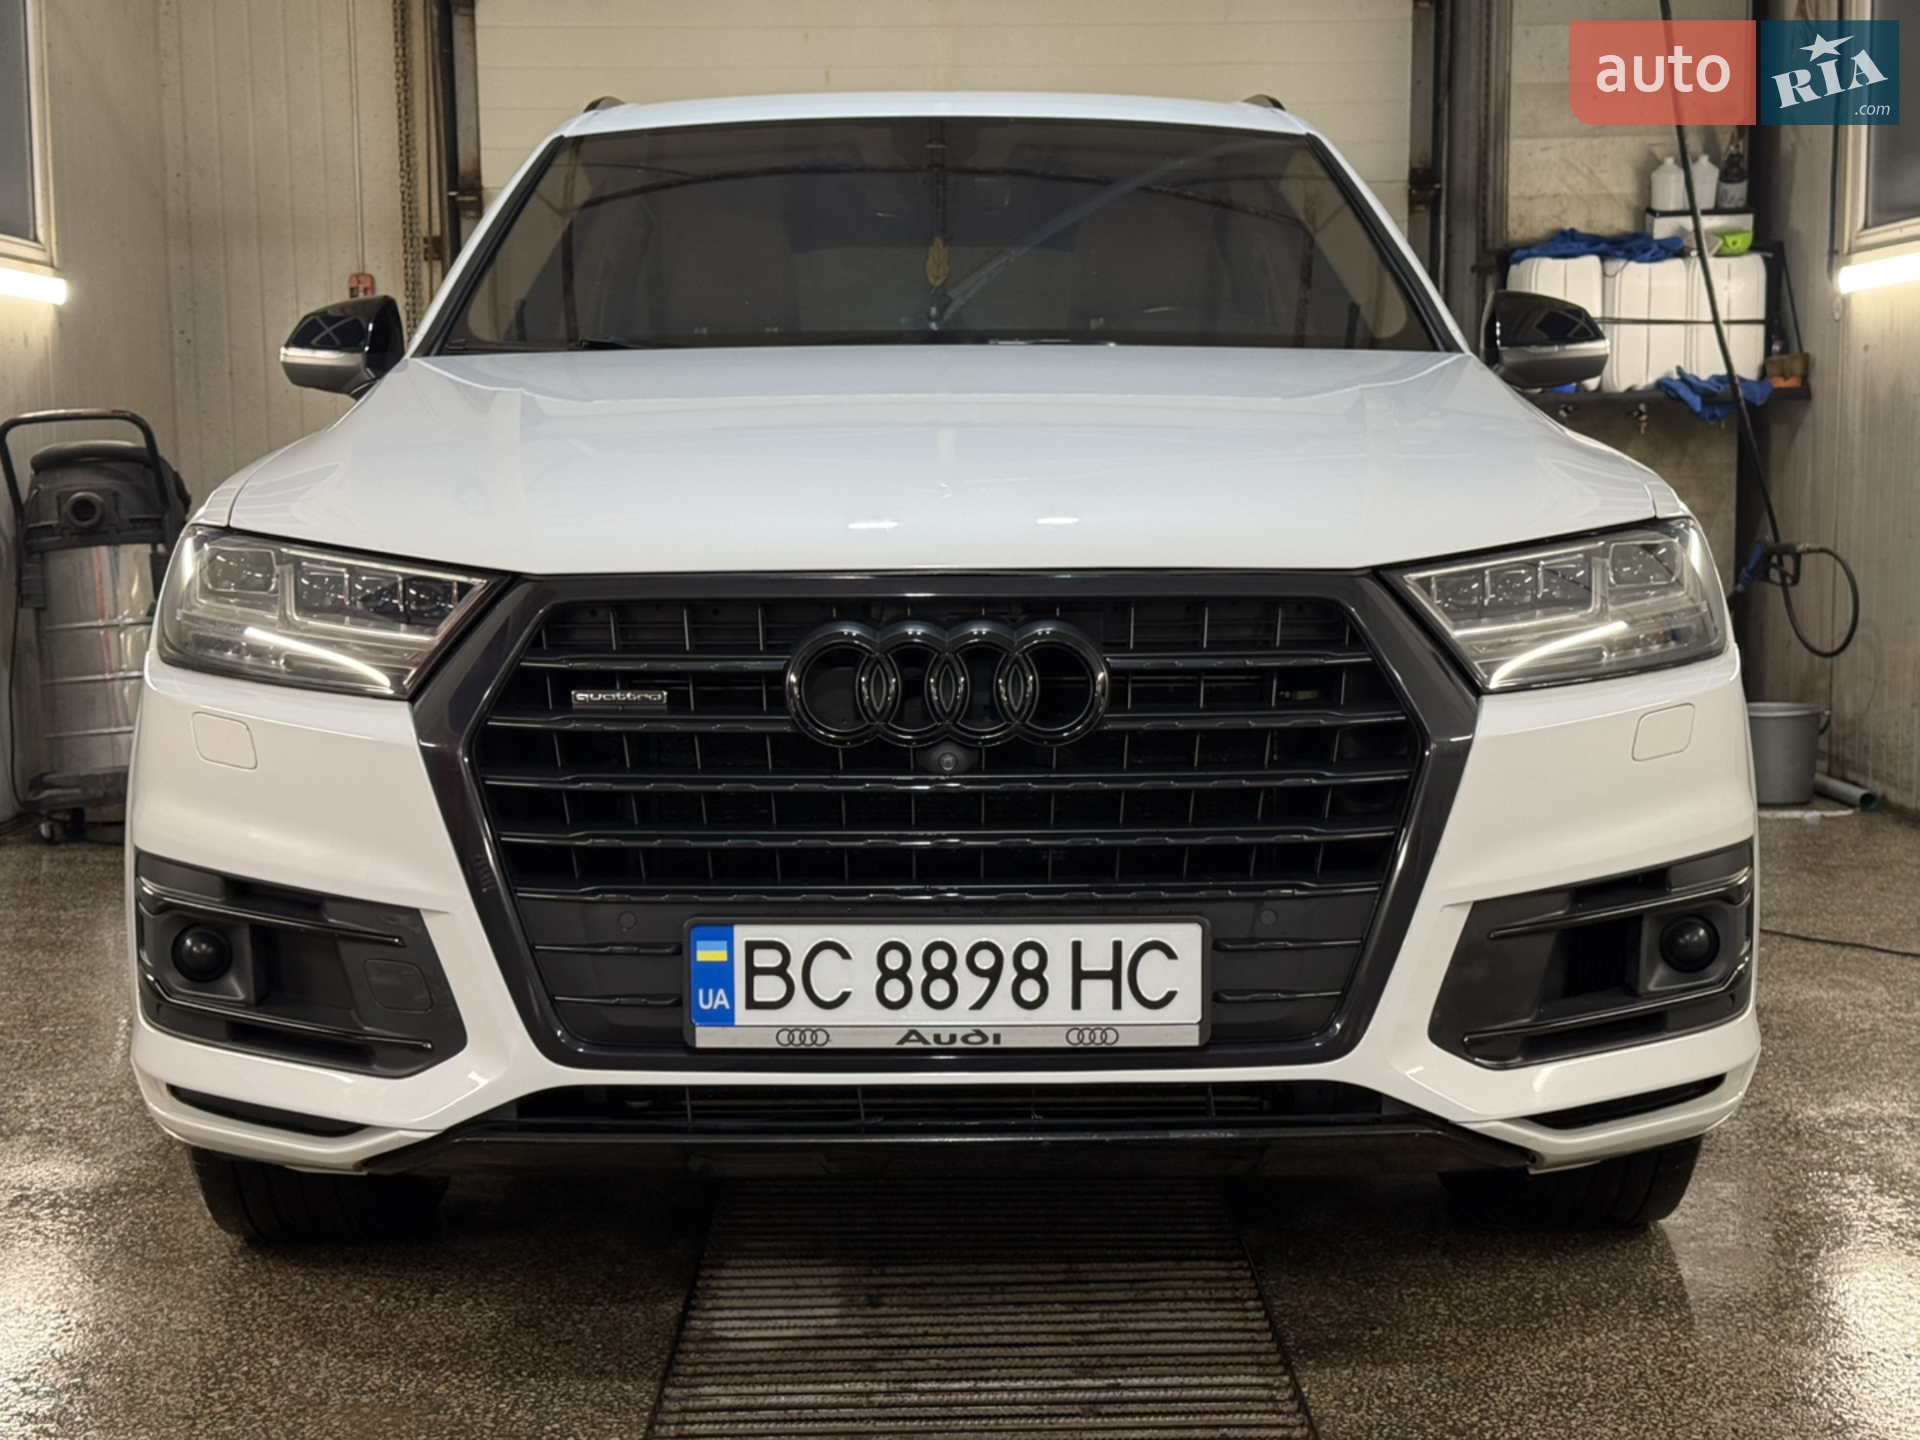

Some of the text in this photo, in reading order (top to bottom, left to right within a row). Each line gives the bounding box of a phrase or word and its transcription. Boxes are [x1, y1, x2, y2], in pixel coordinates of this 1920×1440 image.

[575, 692, 663, 703] quattro
[744, 939, 1179, 1011] BC 8898 HC
[698, 988, 730, 1010] UA
[895, 1028, 1001, 1046] Audi
